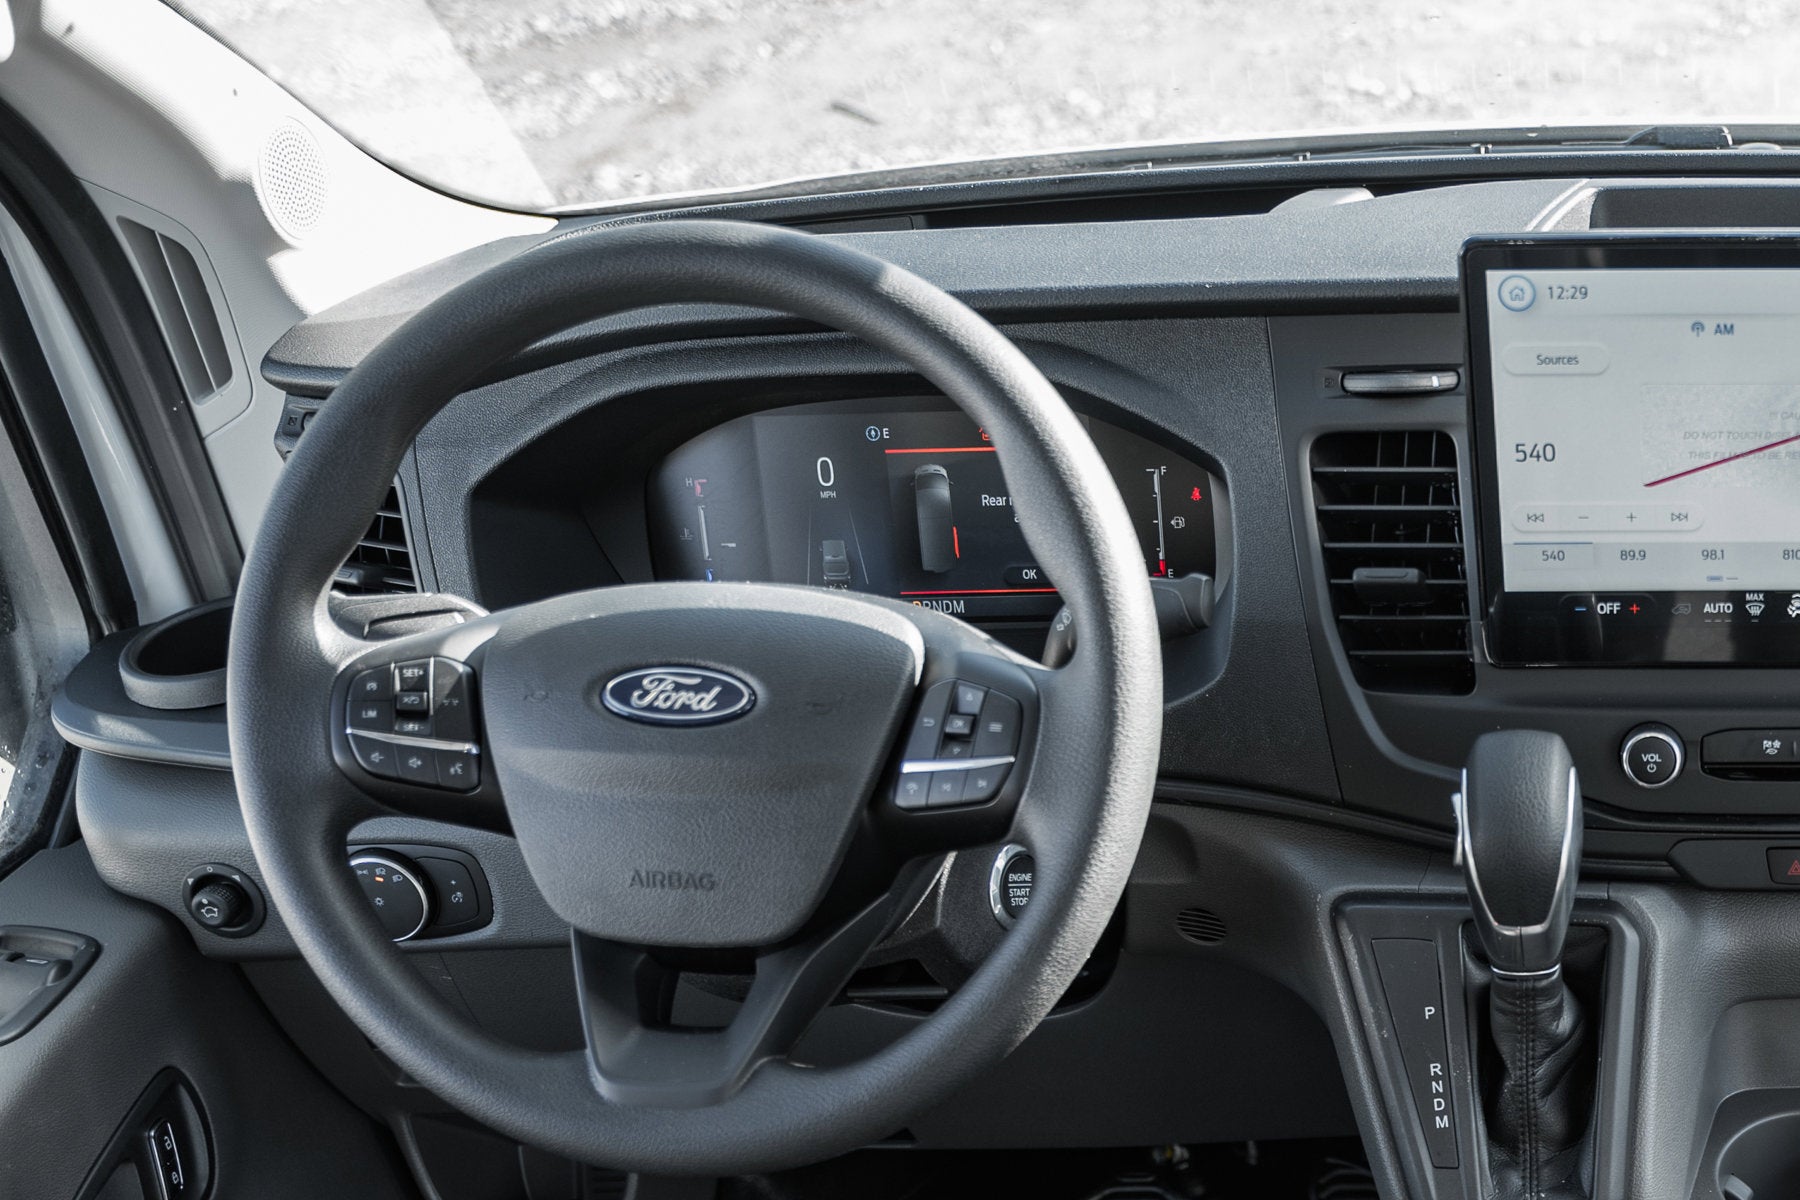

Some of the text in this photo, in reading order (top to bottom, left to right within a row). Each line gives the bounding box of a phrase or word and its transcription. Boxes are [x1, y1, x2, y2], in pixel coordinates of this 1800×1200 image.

[1547, 285, 1589, 301] 12:29
[1713, 322, 1735, 336] AM
[1536, 354, 1580, 366] Sources
[882, 427, 890, 439] E
[1514, 443, 1557, 463] 540
[816, 456, 835, 487] 0
[1160, 465, 1167, 476] F
[685, 477, 693, 487] H
[819, 490, 837, 499] MPH
[981, 494, 1007, 507] Rear
[1541, 550, 1566, 562] 540
[1620, 550, 1647, 561] 89.9
[1701, 549, 1725, 561] 98.1
[1022, 569, 1038, 580] OK
[1167, 568, 1174, 579] E
[1745, 593, 1765, 602] MAX
[1596, 603, 1621, 615] OFF
[1703, 603, 1734, 615] AUTO
[402, 668, 425, 678] SET+
[629, 673, 723, 712] Ford
[361, 710, 378, 719] LIM
[1641, 753, 1662, 763] VOL
[628, 869, 716, 892] AIRBAG
[1008, 873, 1033, 882] ENGINE
[1008, 888, 1031, 897] START
[1010, 897, 1029, 906] STOP
[1424, 1006, 1436, 1020] P
[1429, 1063, 1443, 1077] R
[1431, 1080, 1444, 1094] N
[1433, 1098, 1446, 1112] D
[1435, 1116, 1450, 1129] M
